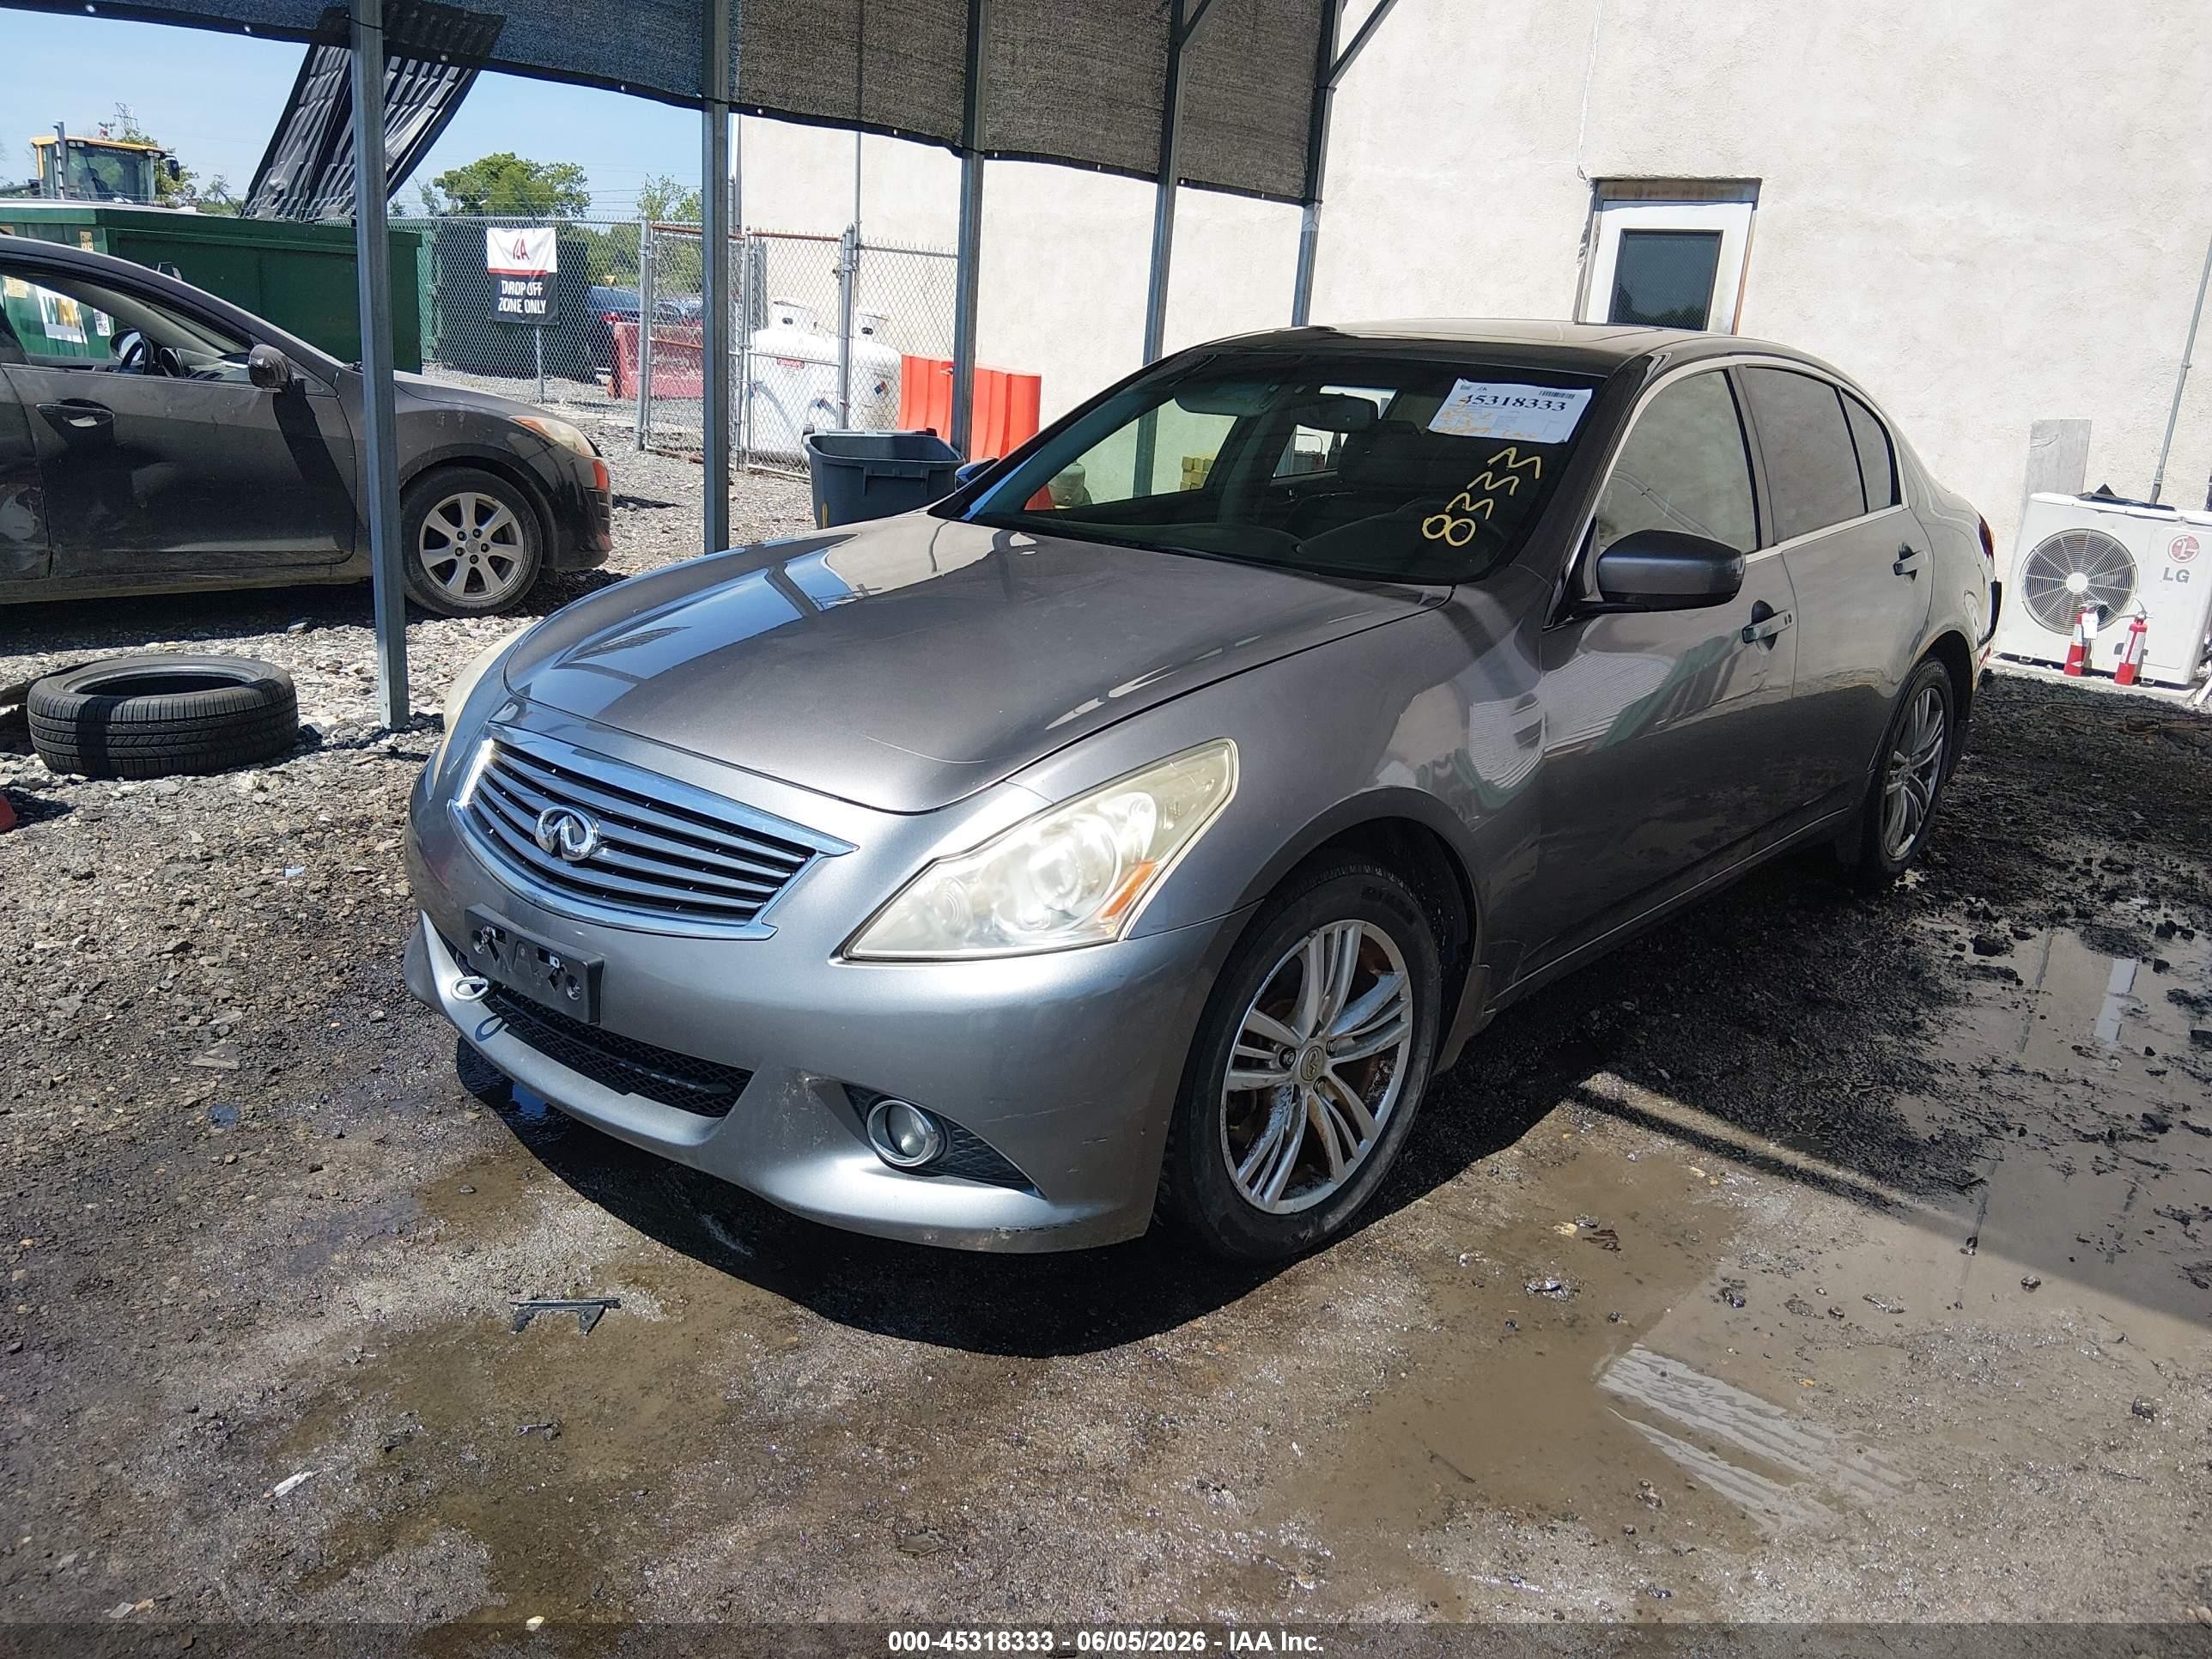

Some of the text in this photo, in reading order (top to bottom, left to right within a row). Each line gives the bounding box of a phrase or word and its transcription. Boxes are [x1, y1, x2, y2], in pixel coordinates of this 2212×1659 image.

[501, 279, 543, 297] DROP OFF
[498, 297, 547, 315] ZONE ONLY
[1459, 394, 1567, 412] 45318333
[2162, 567, 2191, 584] LG
